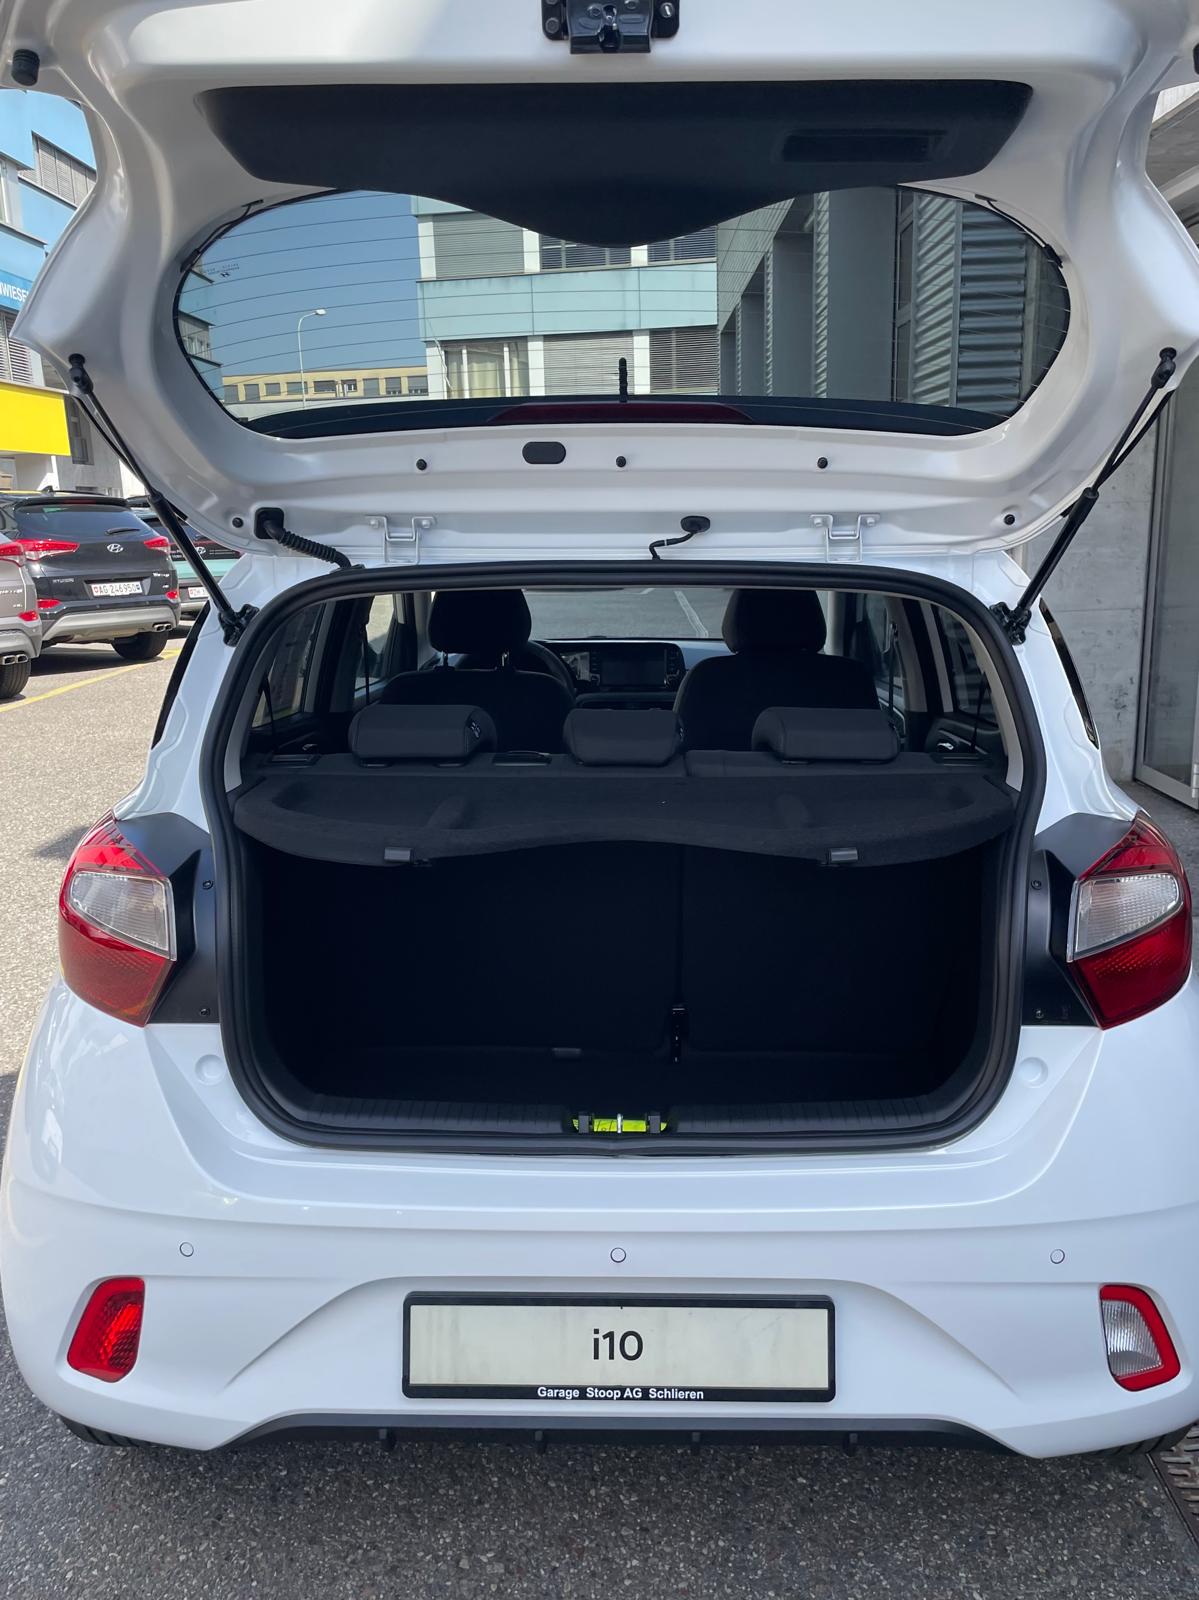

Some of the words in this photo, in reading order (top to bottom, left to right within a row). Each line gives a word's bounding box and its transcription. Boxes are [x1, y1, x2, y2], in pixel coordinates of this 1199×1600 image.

[592, 1328, 644, 1361] i10
[537, 1386, 580, 1400] Garage
[586, 1387, 621, 1400] Stoop
[623, 1388, 643, 1398] AG
[648, 1388, 704, 1400] Schlieren
